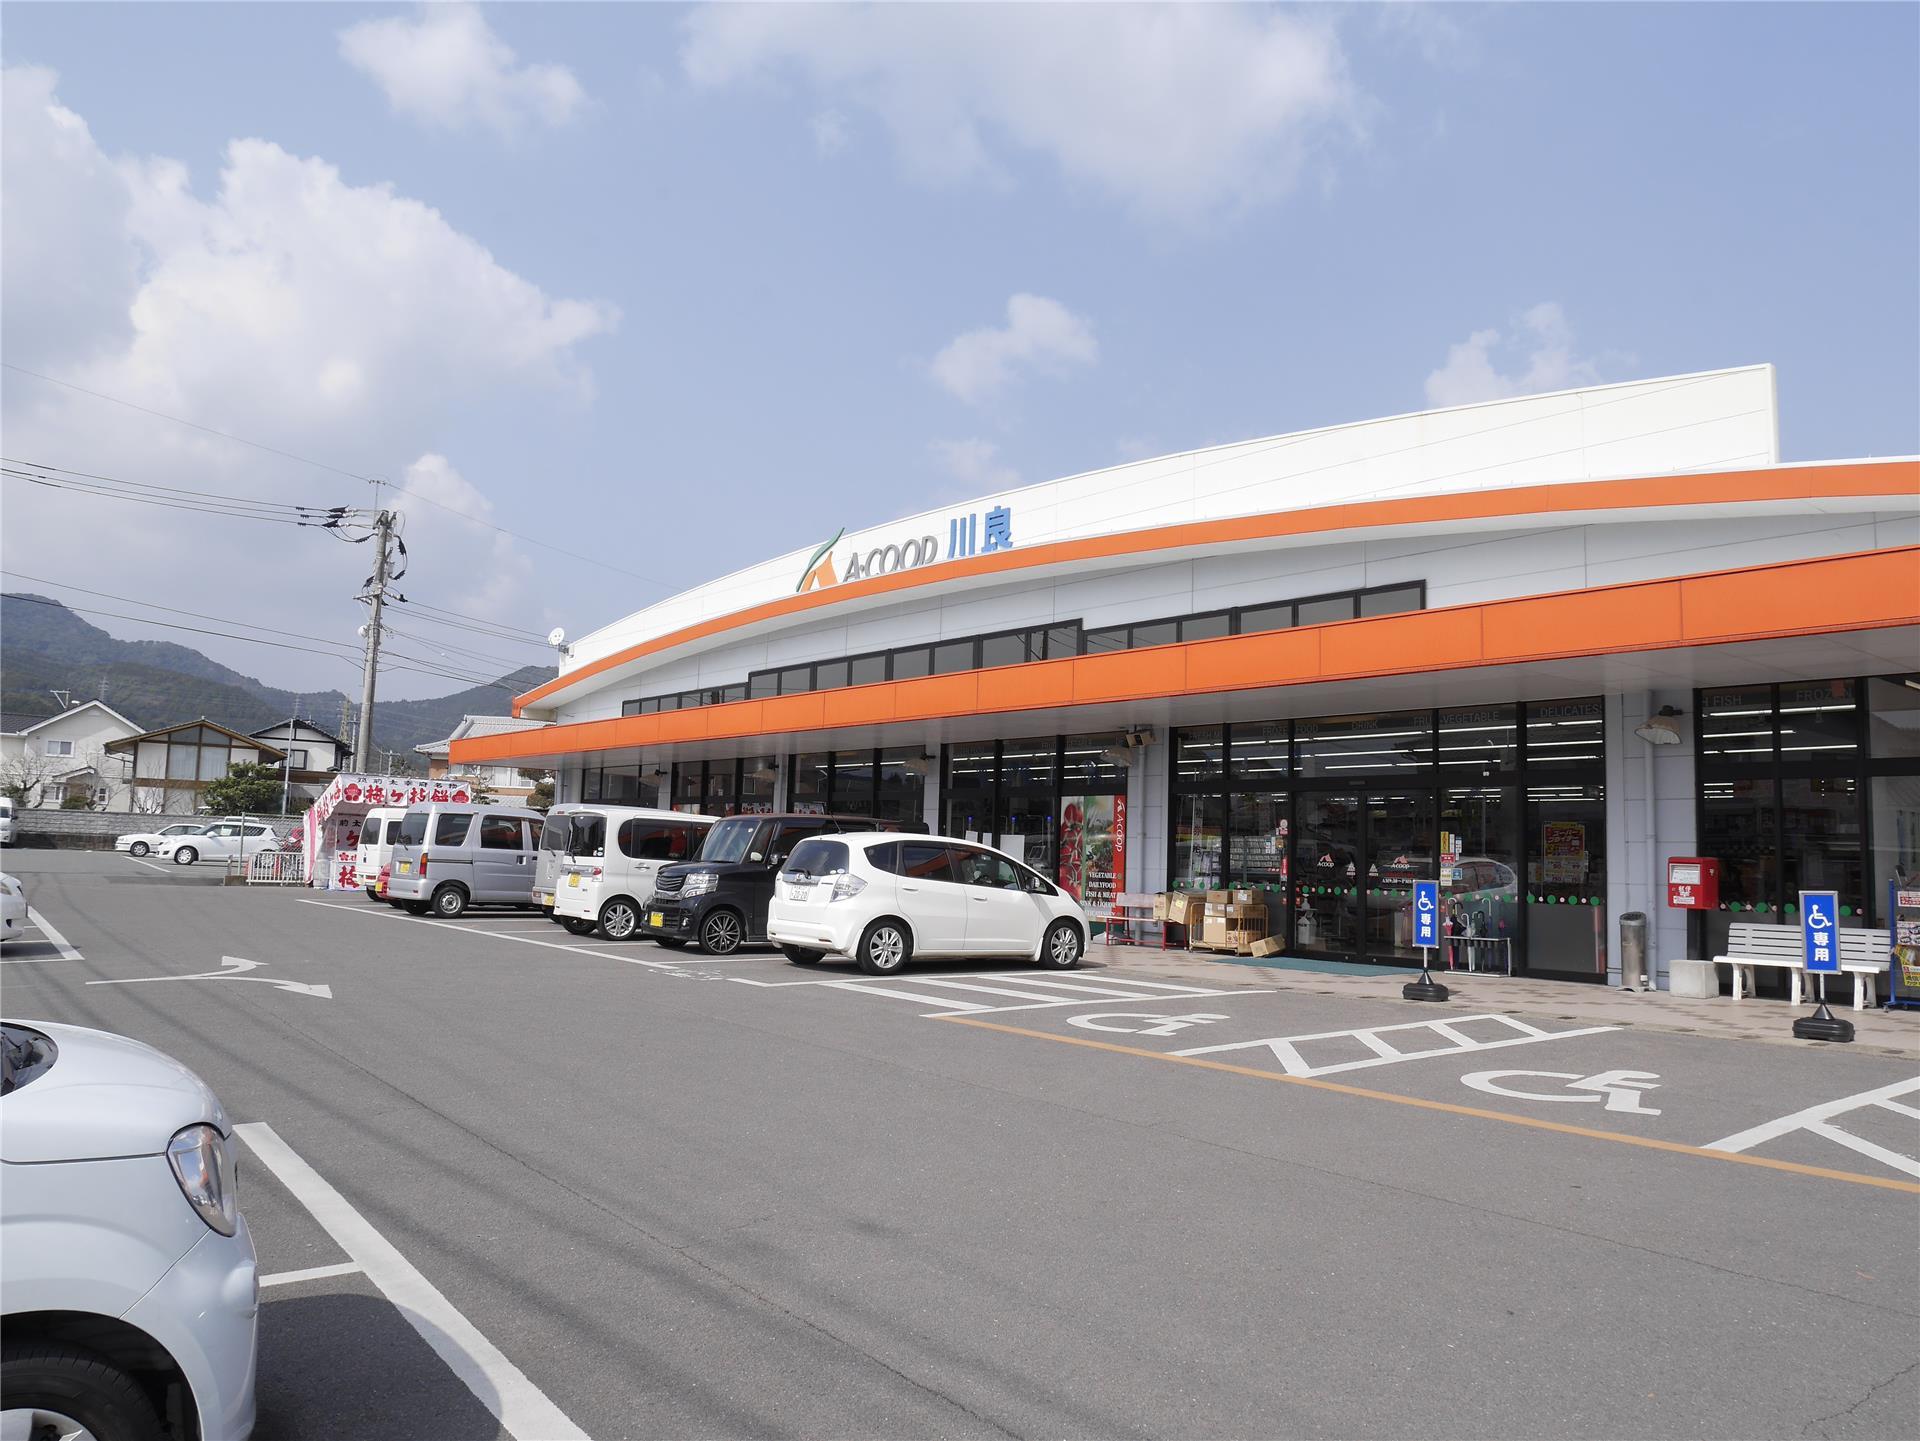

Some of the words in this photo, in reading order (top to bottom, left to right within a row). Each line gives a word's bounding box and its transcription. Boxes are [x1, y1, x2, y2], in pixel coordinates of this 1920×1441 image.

[948, 505, 1013, 560] 川良
[1712, 696, 1742, 705] FISH
[1443, 711, 1500, 723] VEGETABLE
[1262, 726, 1289, 736] FROZE
[1420, 913, 1432, 938] 専用
[1813, 931, 1829, 962] 専用
